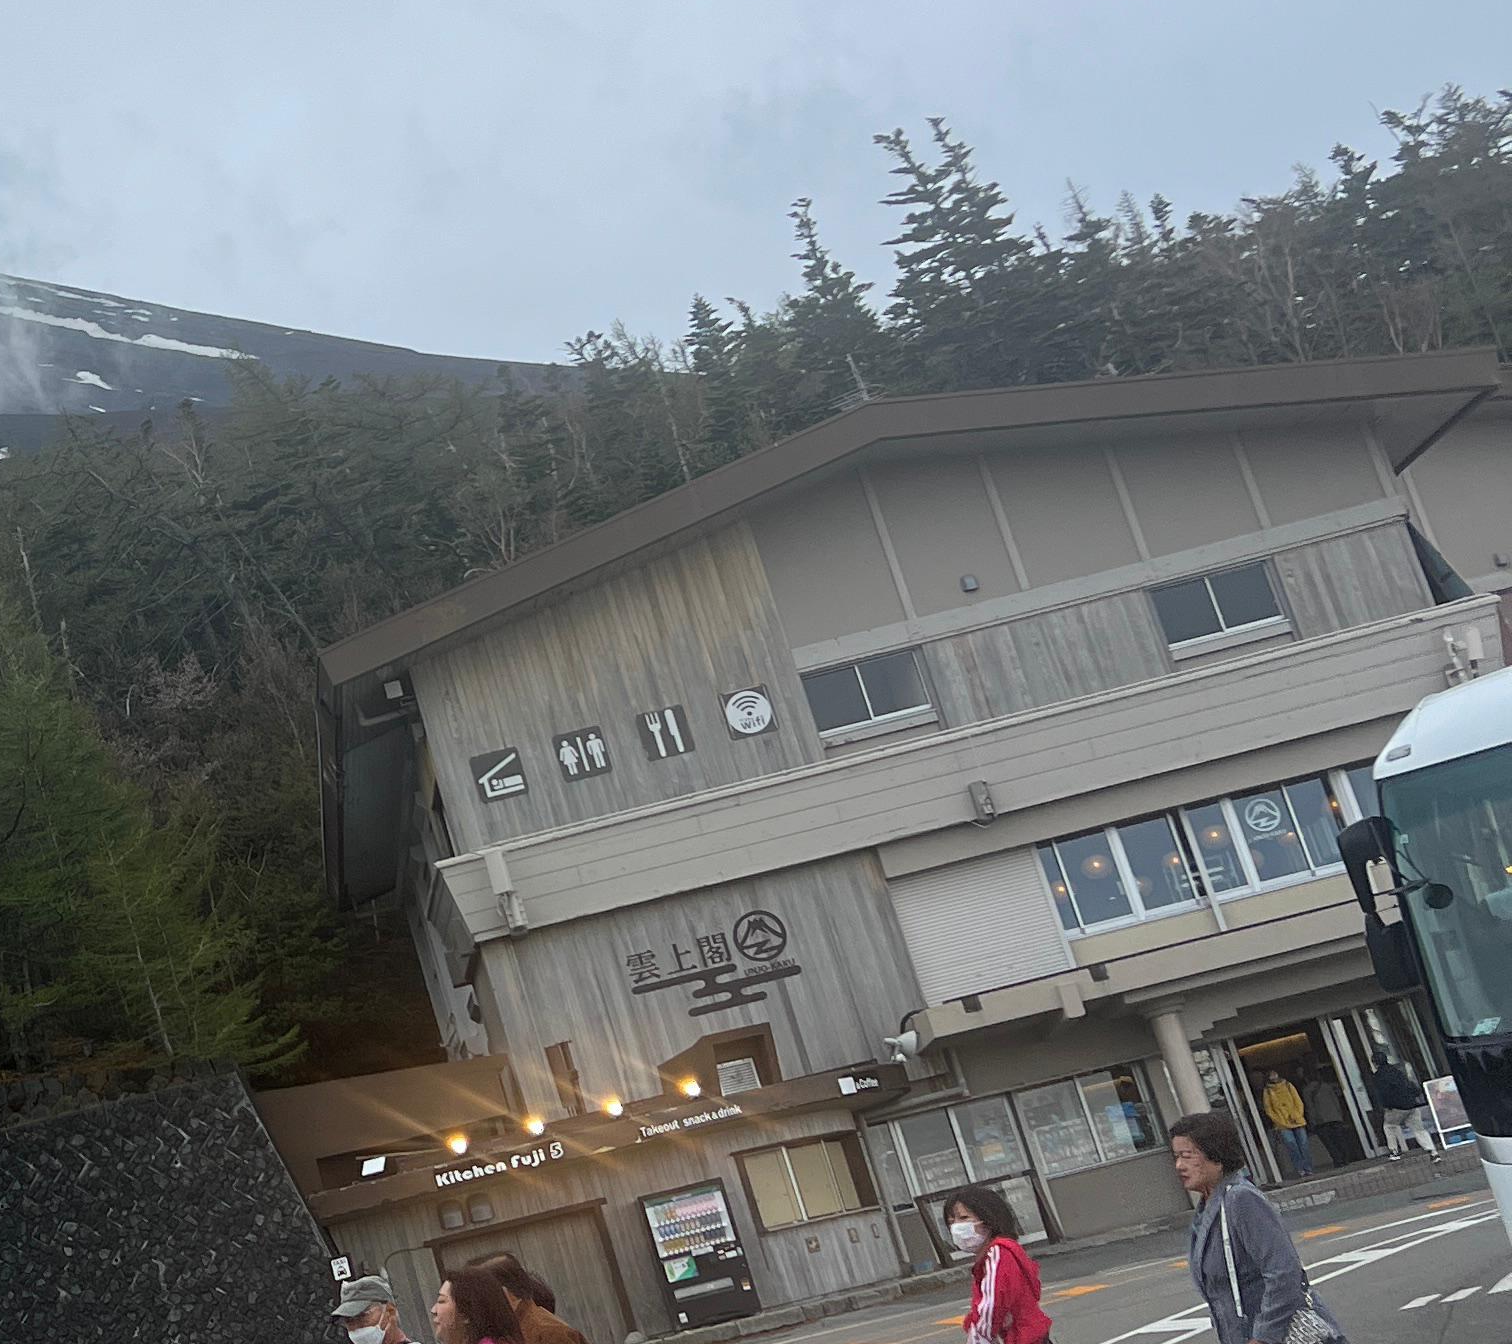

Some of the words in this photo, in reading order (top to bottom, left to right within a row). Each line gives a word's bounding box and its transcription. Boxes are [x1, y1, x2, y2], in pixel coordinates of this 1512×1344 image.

[626, 931, 732, 984] 雲上閣
[743, 958, 796, 977] UNJO-KAKU
[639, 1119, 681, 1137] Takeout
[434, 1161, 508, 1188] Kitchen
[549, 1141, 565, 1160] 5
